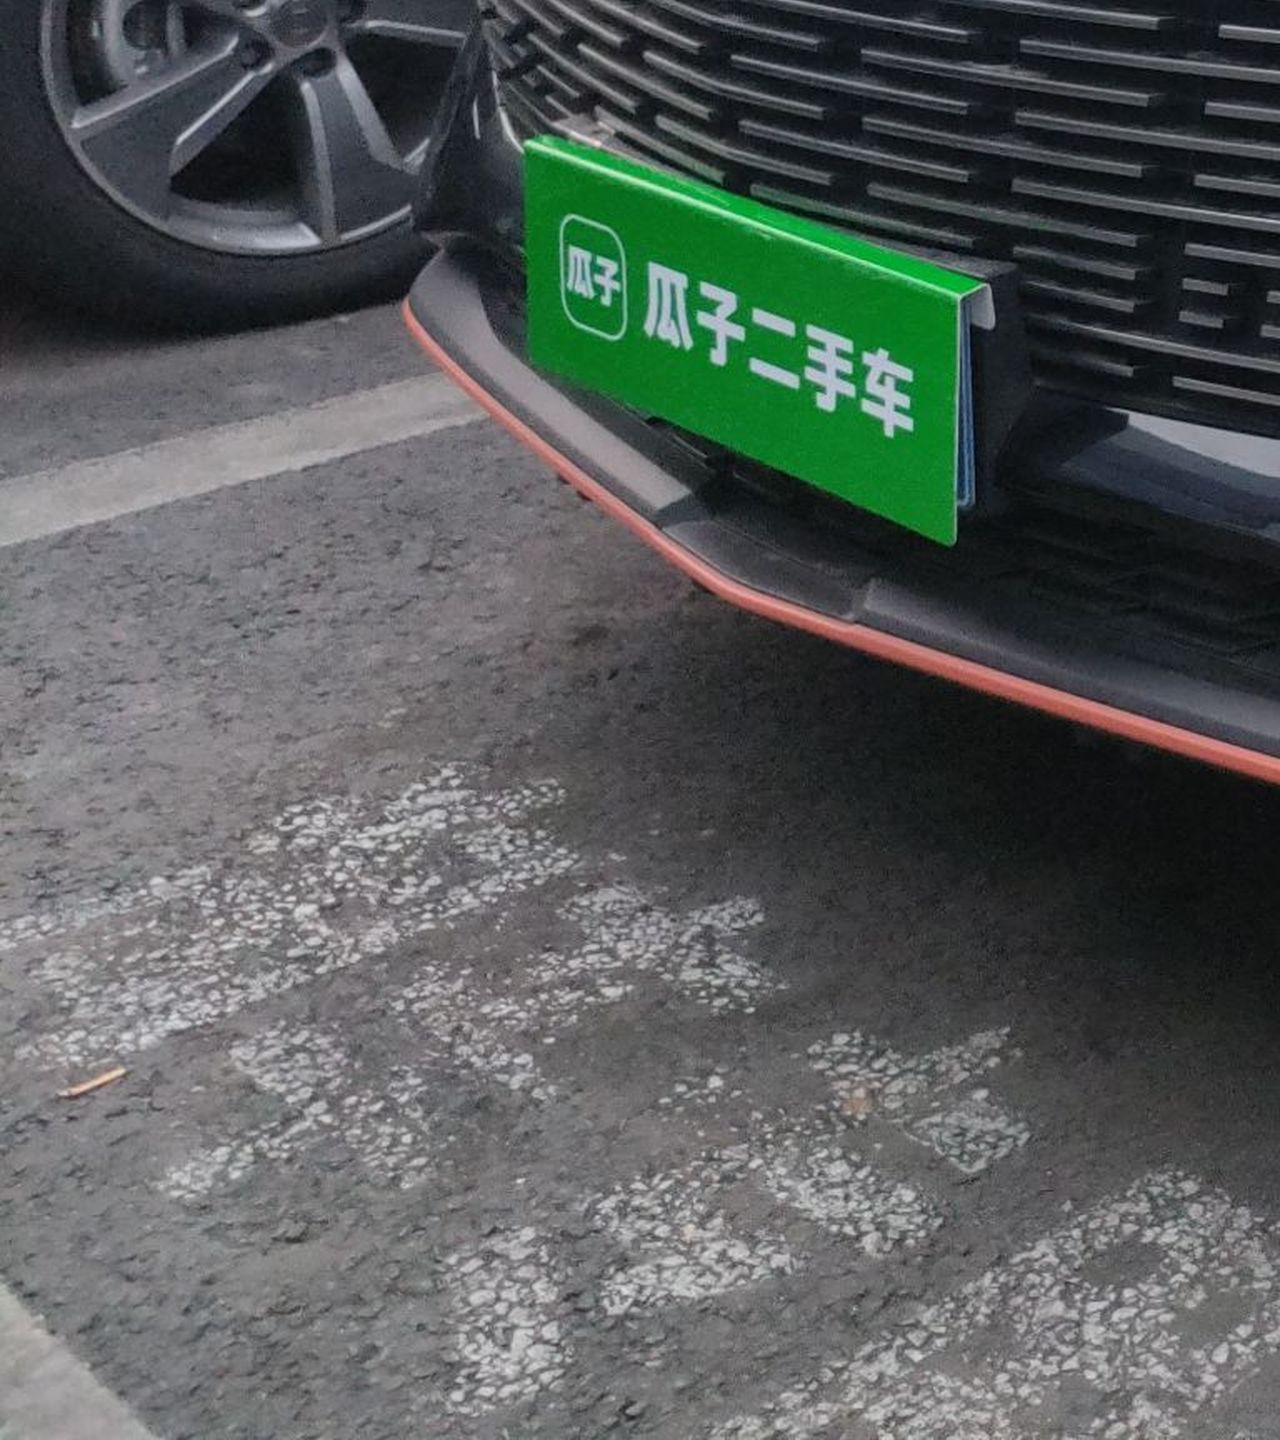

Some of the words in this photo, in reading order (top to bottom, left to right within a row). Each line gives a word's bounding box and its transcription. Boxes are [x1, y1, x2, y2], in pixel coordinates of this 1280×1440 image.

[567, 245, 622, 307] 瓜子
[643, 261, 915, 439] 瓜子二手车
